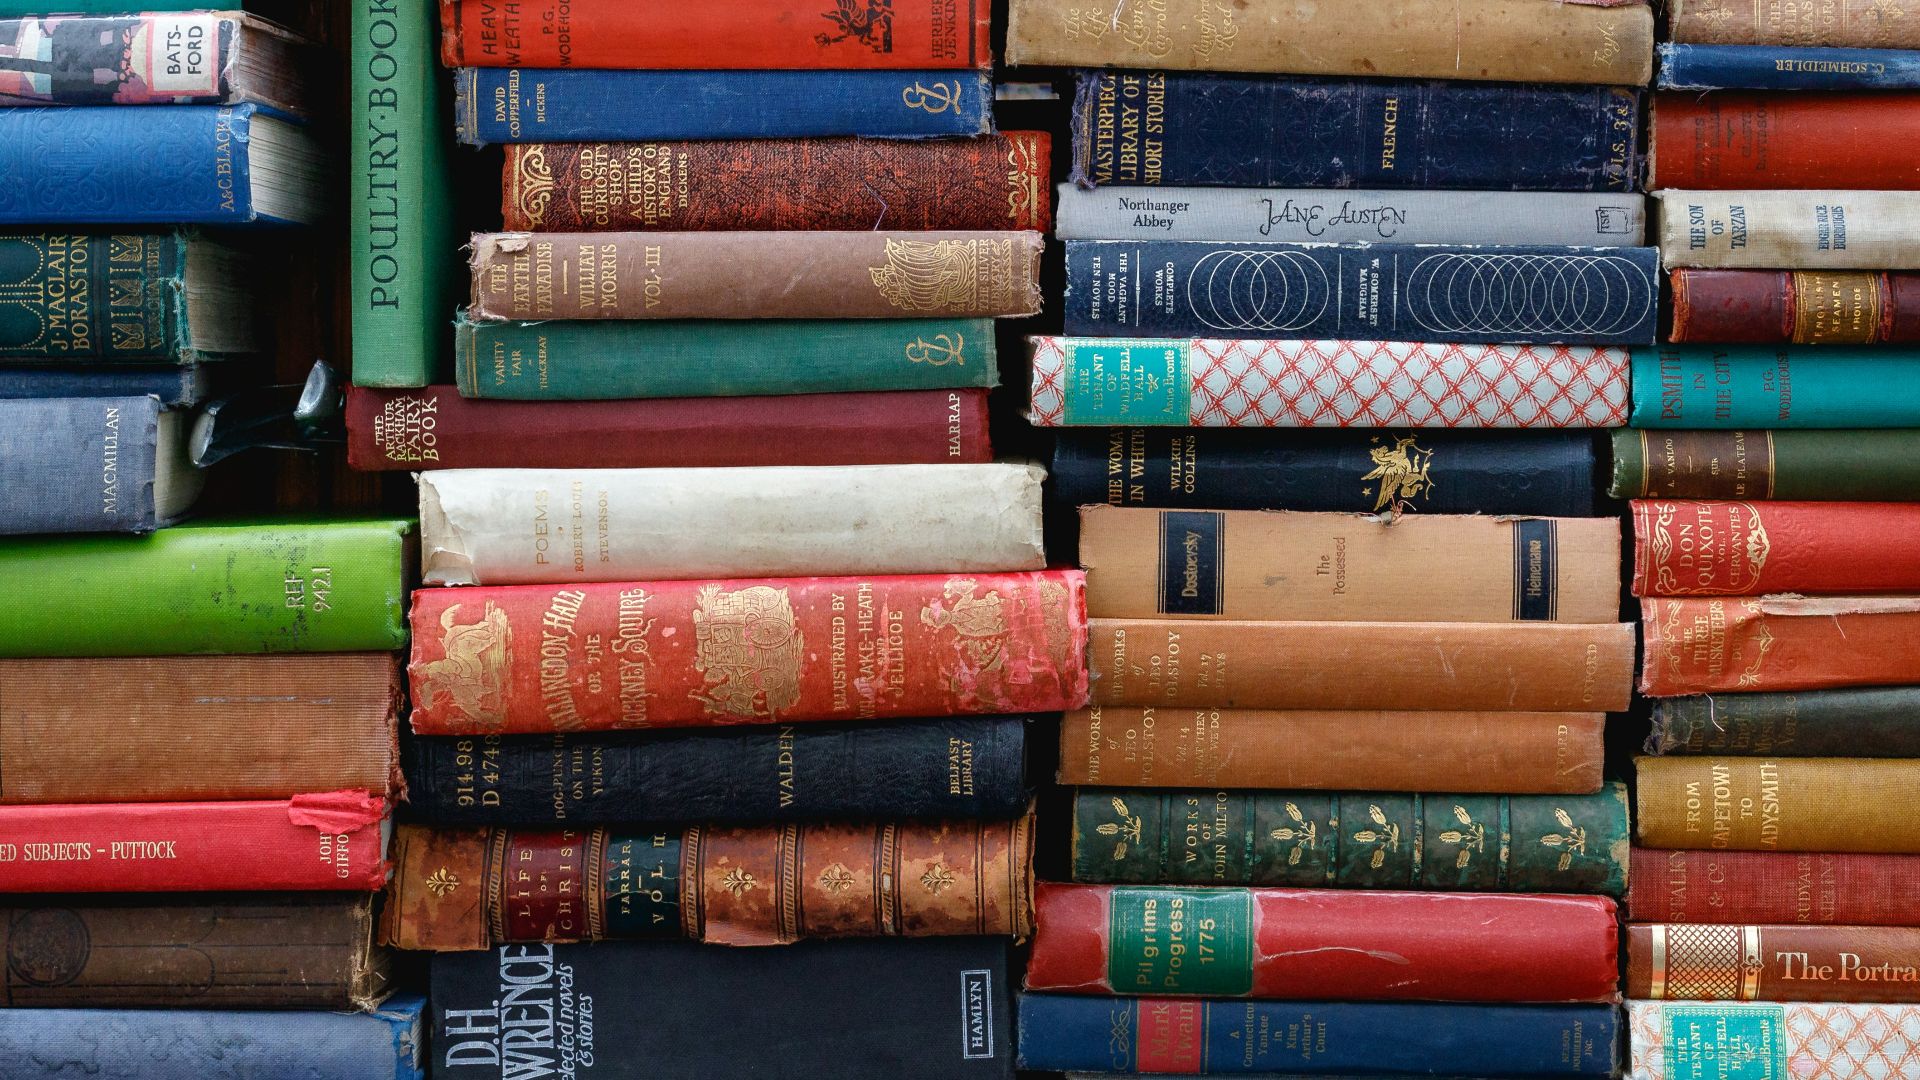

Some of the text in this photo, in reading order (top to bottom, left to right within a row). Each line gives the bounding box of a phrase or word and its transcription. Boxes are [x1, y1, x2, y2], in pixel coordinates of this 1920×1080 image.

[542, 5, 555, 35] P.G.
[1063, 8, 1080, 40] The
[1081, 7, 1109, 44] Life
[167, 25, 181, 75] BATS-
[187, 26, 203, 75] FORD
[1775, 59, 1868, 73] SCHMEIDLER
[496, 86, 506, 122] DAVID
[509, 69, 520, 138] COPPERFIELD
[536, 83, 545, 122] DICKENS
[1121, 75, 1140, 180] LIBRARY OF
[1144, 72, 1165, 184] SHORT STORIES
[1382, 98, 1398, 170] FRENCH
[581, 149, 593, 217] THE OLD
[595, 145, 609, 225] CURIOSITY
[610, 159, 622, 206] SHOP
[627, 147, 642, 205] CHILD'S
[643, 166, 657, 225] HISTORY
[658, 146, 671, 218] ENGLAND
[678, 152, 687, 208] DICKENS
[1119, 198, 1189, 212] Northanger
[1133, 214, 1174, 230] Abbey
[1260, 199, 1408, 238] JANE AUSTEN
[1689, 204, 1706, 250] THE SON
[1712, 220, 1724, 235] OF
[1730, 204, 1747, 249] TARZAN
[1831, 205, 1847, 250] BURROUGHS
[491, 264, 507, 294] THE
[537, 242, 553, 313] PARADISE
[580, 244, 595, 309] WILLIAM
[601, 244, 617, 308] MORRIS
[978, 238, 989, 282] SILVER
[70, 236, 90, 350] BORASTON
[1092, 280, 1100, 320] NOVELS
[1107, 273, 1115, 302] MOOD
[1118, 275, 1127, 324] VAGRANT
[1154, 269, 1163, 306] WORKS
[1165, 261, 1174, 314] COMPLETE
[1359, 268, 1368, 319] MAUGHAM
[1369, 273, 1380, 327] SOMERSET
[1814, 276, 1822, 337] ENGLISH
[1832, 280, 1841, 332] SEAMEN
[1853, 287, 1862, 330] FROUDE
[495, 341, 505, 385] VANITY
[512, 350, 522, 376] FAIR
[539, 336, 549, 389] THACKERAY
[1080, 368, 1089, 396] THE
[1107, 373, 1117, 391] OF
[1659, 349, 1683, 420] PSMITH
[1693, 373, 1706, 390] IN
[1714, 352, 1731, 420] THE CITY
[1763, 368, 1774, 392] P.G.
[1777, 352, 1792, 420] WODEHOUSE
[375, 415, 385, 445] THE
[385, 400, 396, 461] ARTHUR
[395, 396, 406, 461] RACKHAM
[407, 395, 421, 462] FAIRY
[422, 397, 439, 461] BOOK
[949, 393, 960, 456] HARRAP
[104, 407, 119, 514] MACMILLAN
[1130, 429, 1145, 502] IN WHITE
[1170, 438, 1181, 490] WILKIE
[1185, 435, 1195, 494] COLLINS
[1666, 438, 1675, 474] VANLOO
[1736, 432, 1746, 496] LE PLATEAU
[1109, 479, 1122, 504] THE
[535, 489, 549, 564] POEMS
[573, 525, 584, 572] ROBERT
[598, 490, 609, 562] STEVENSON
[1680, 523, 1694, 567] DON
[1697, 505, 1714, 586] QUIXOTE
[1729, 506, 1742, 586] CERVANTES
[1182, 531, 1202, 597] Dostoevsky
[1317, 554, 1330, 577] The
[1333, 536, 1346, 596] Possessed
[1527, 540, 1541, 597] Heinemann
[285, 574, 304, 608] REF
[542, 590, 586, 637] HALL
[584, 634, 602, 693] OR THE
[832, 593, 848, 711] ILLUSTRATED BY
[888, 611, 905, 697] JELLICOE
[1114, 629, 1126, 674] WORKS
[1684, 627, 1692, 653] THE
[1694, 615, 1708, 665] THREE
[1708, 600, 1725, 679] MUSKETEERS
[1089, 704, 1101, 782] THE WORKS
[1109, 737, 1120, 750] of
[1125, 729, 1136, 762] LEO
[1142, 706, 1155, 783] TOLSTOY
[1196, 712, 1205, 744] THEN
[456, 740, 475, 806] 914.98
[483, 735, 500, 806] D 4748
[573, 746, 583, 799] ON THE
[592, 746, 603, 795] YUKON
[780, 726, 794, 808] WALDEN
[949, 737, 960, 795] BELFAST
[962, 740, 973, 796] LIBRARY
[1186, 799, 1198, 863] WORKS
[1202, 823, 1211, 839] OF
[1687, 782, 1700, 832] FROM
[1740, 798, 1753, 819] TO
[24, 841, 176, 861] SUBJECTS PUTTOCK
[1215, 844, 1226, 879] JOHN
[519, 849, 533, 917] LIFE
[540, 871, 547, 891] OF
[560, 831, 575, 930] CHRIST
[1670, 850, 1687, 921] STALKY
[1709, 897, 1724, 908] &
[1137, 898, 1159, 985] Pilgrims
[1165, 898, 1187, 987] Progress
[1200, 918, 1216, 965] 1775
[1776, 951, 1833, 981] The
[556, 963, 573, 1020] novels
[971, 981, 983, 1048] HAMLYN
[445, 1000, 499, 1067] D.H.
[575, 993, 594, 1067] & stories
[1258, 1015, 1269, 1056] Yankee
[1286, 1023, 1299, 1049] King
[1302, 1013, 1312, 1059] Arthur's
[1316, 1022, 1327, 1053] Court
[1677, 1037, 1688, 1062] THE
[1690, 1022, 1702, 1079] TENANT
[1705, 1042, 1714, 1060] OF
[1731, 1034, 1741, 1070] HALL
